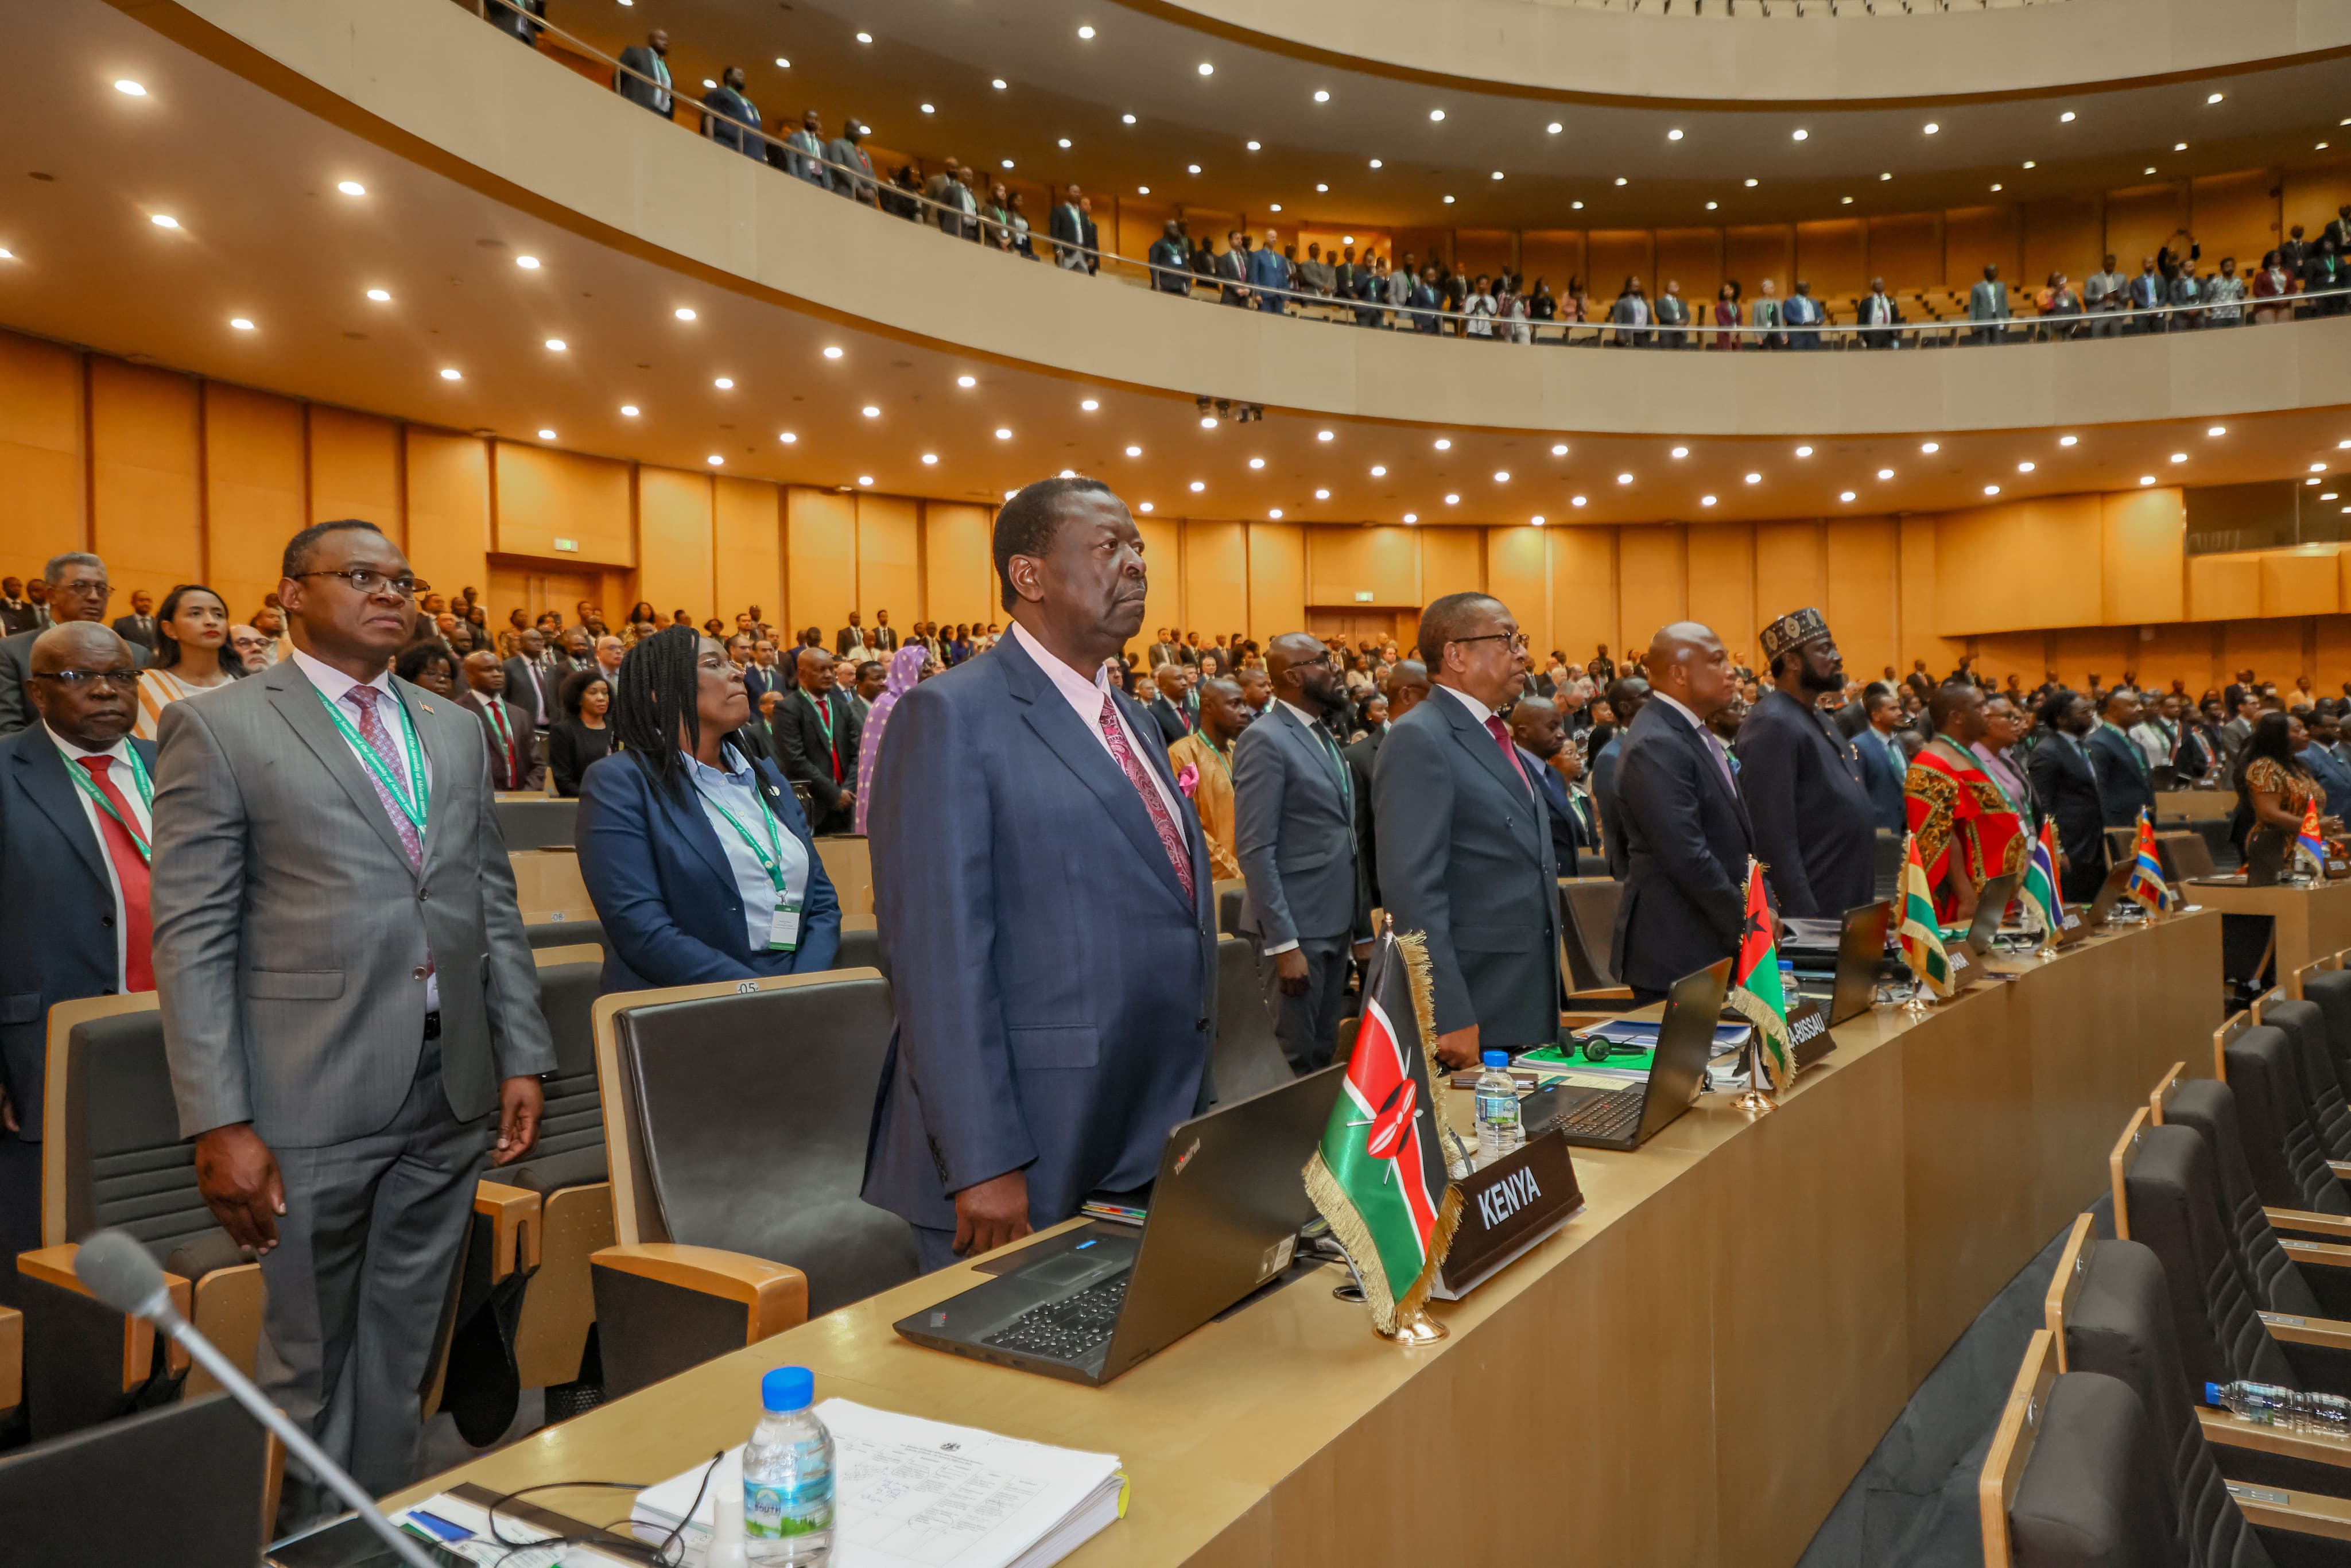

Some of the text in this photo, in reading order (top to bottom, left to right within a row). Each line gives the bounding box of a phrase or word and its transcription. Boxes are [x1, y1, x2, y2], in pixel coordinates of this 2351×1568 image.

[322, 701, 342, 722] Ordinary
[339, 721, 358, 739] Session
[360, 744, 370, 752] the
[367, 752, 387, 777] Assembly
[390, 782, 406, 803] African
[404, 803, 417, 819] union
[410, 748, 421, 773] Assembly
[416, 779, 425, 800] African
[754, 844, 764, 857] union
[1787, 1012, 1826, 1049] A-BISSAU
[1477, 1166, 1542, 1231] KENYA
